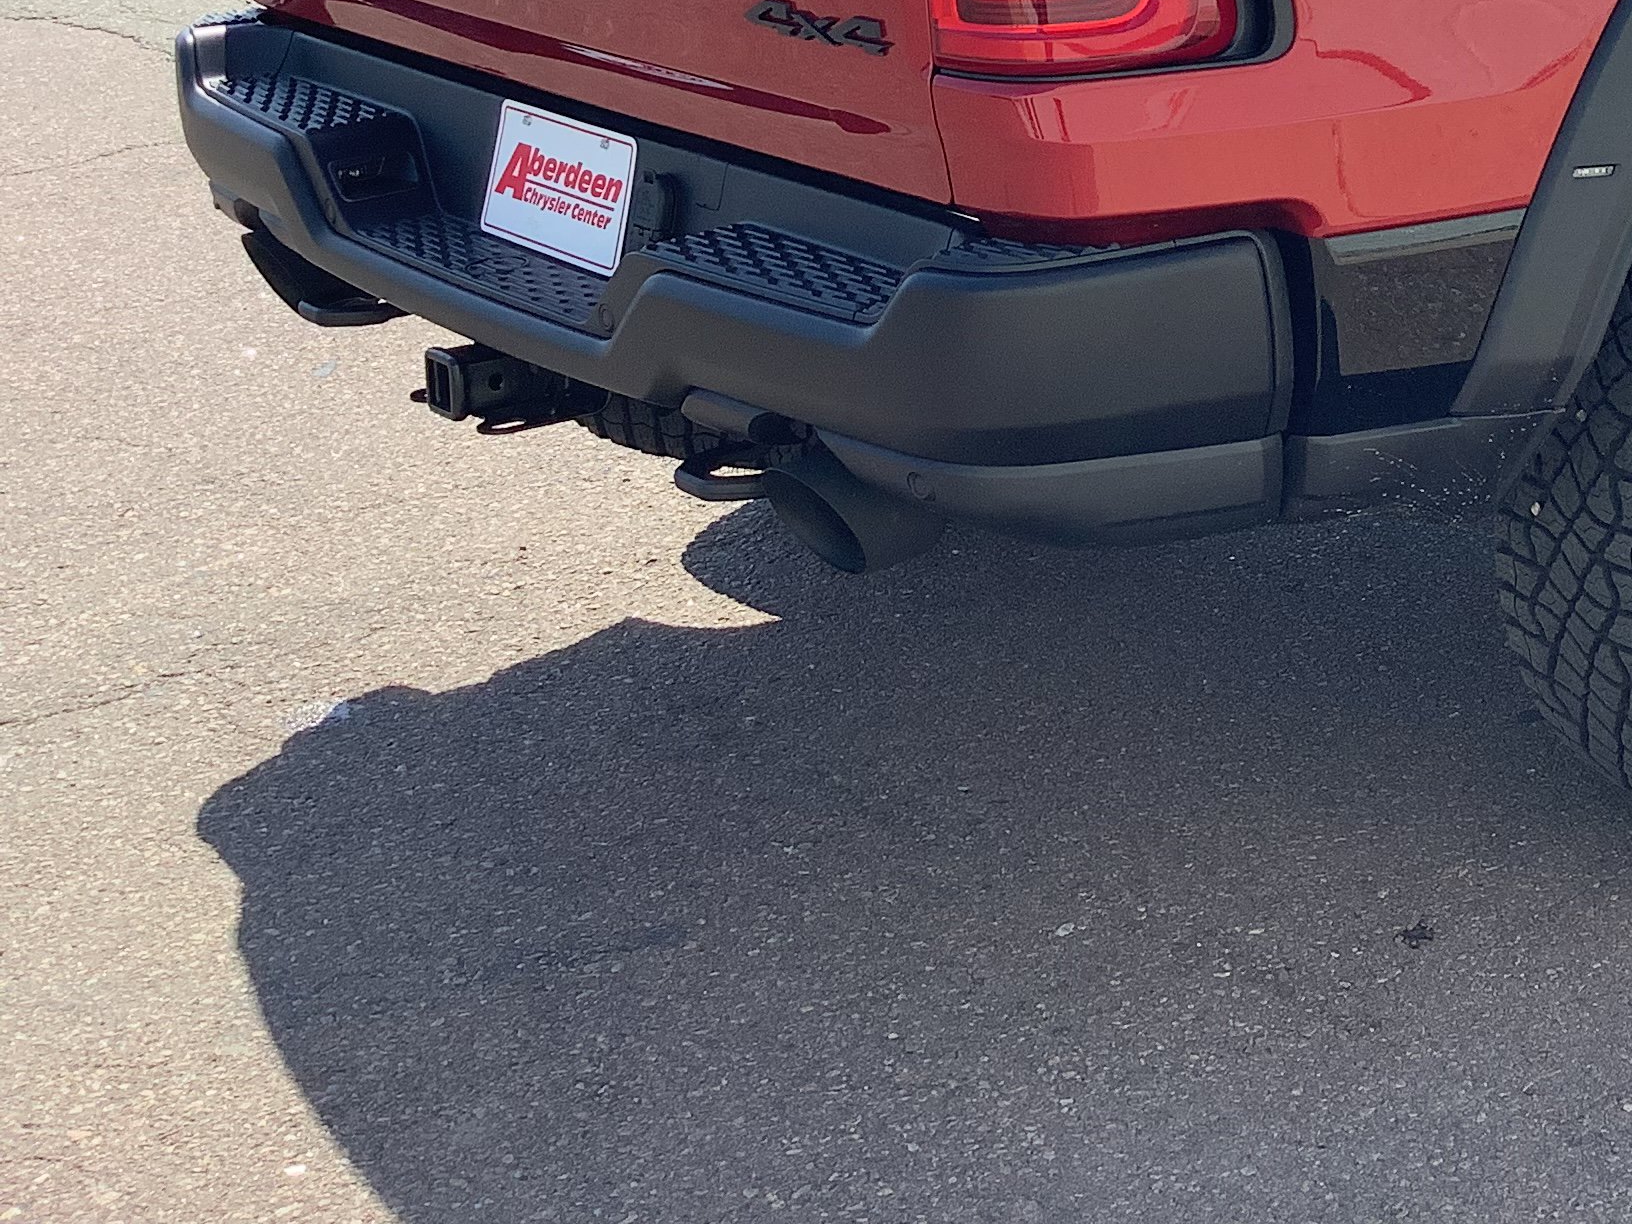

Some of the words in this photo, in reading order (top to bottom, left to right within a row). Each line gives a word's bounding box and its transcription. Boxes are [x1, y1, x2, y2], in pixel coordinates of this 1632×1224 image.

[495, 142, 623, 203] Aberdeen
[523, 187, 571, 216] Chrysler
[571, 203, 612, 230] Center
